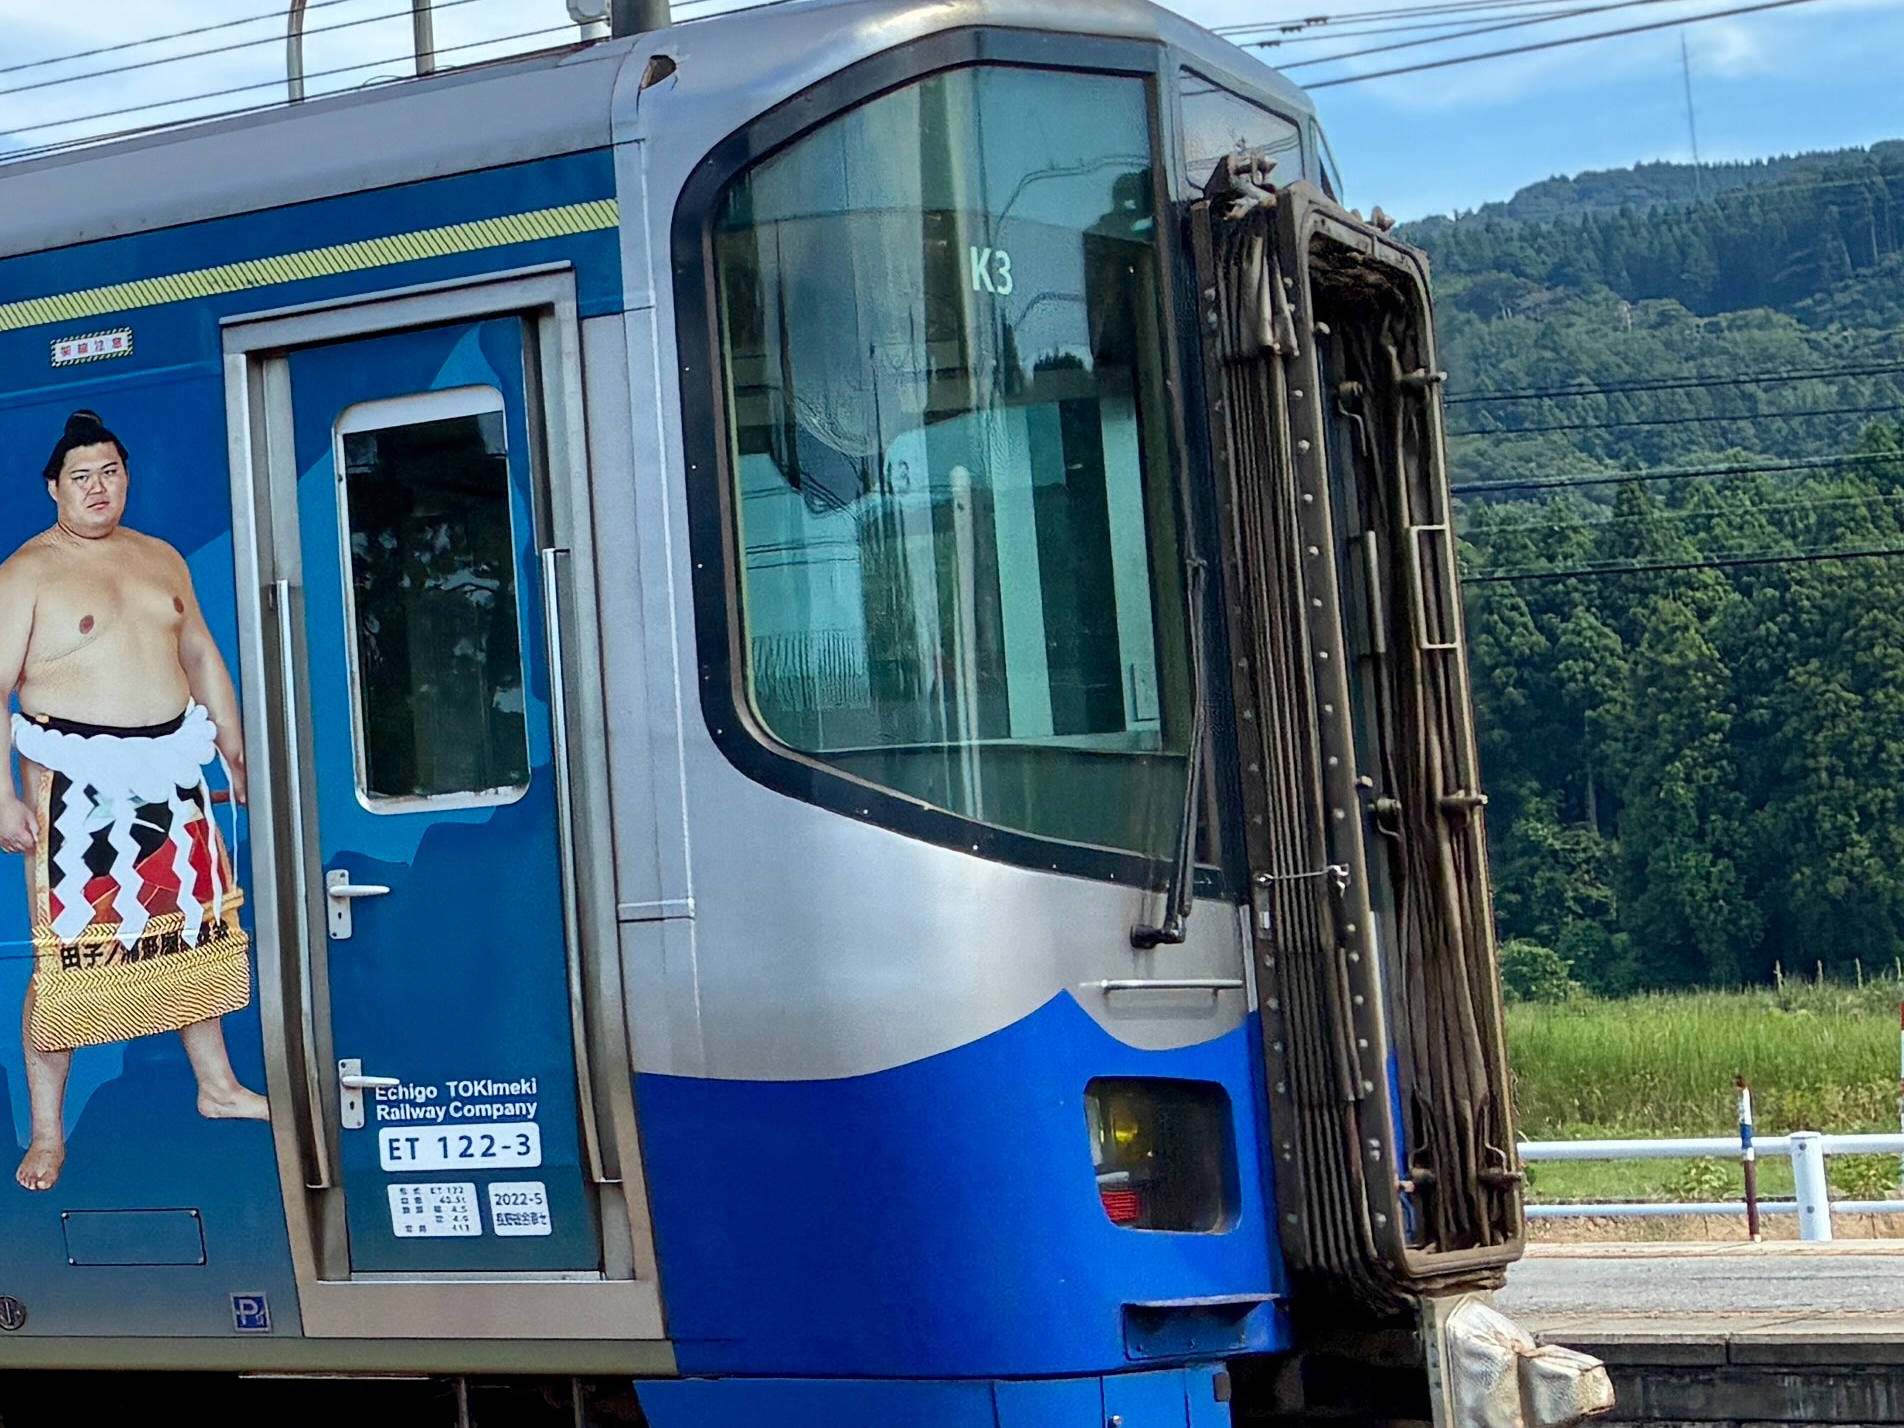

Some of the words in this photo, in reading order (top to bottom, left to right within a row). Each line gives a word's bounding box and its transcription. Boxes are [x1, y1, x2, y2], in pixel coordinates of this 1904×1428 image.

[970, 246, 1013, 295] K3
[376, 1082, 438, 1103] Echigo
[445, 1077, 538, 1098] TOKImeki
[376, 1103, 447, 1123] Railway
[448, 1100, 538, 1120] Company
[388, 1136, 420, 1161] ET
[437, 1133, 532, 1160] 122-3
[494, 1193, 543, 1206] 2022-5
